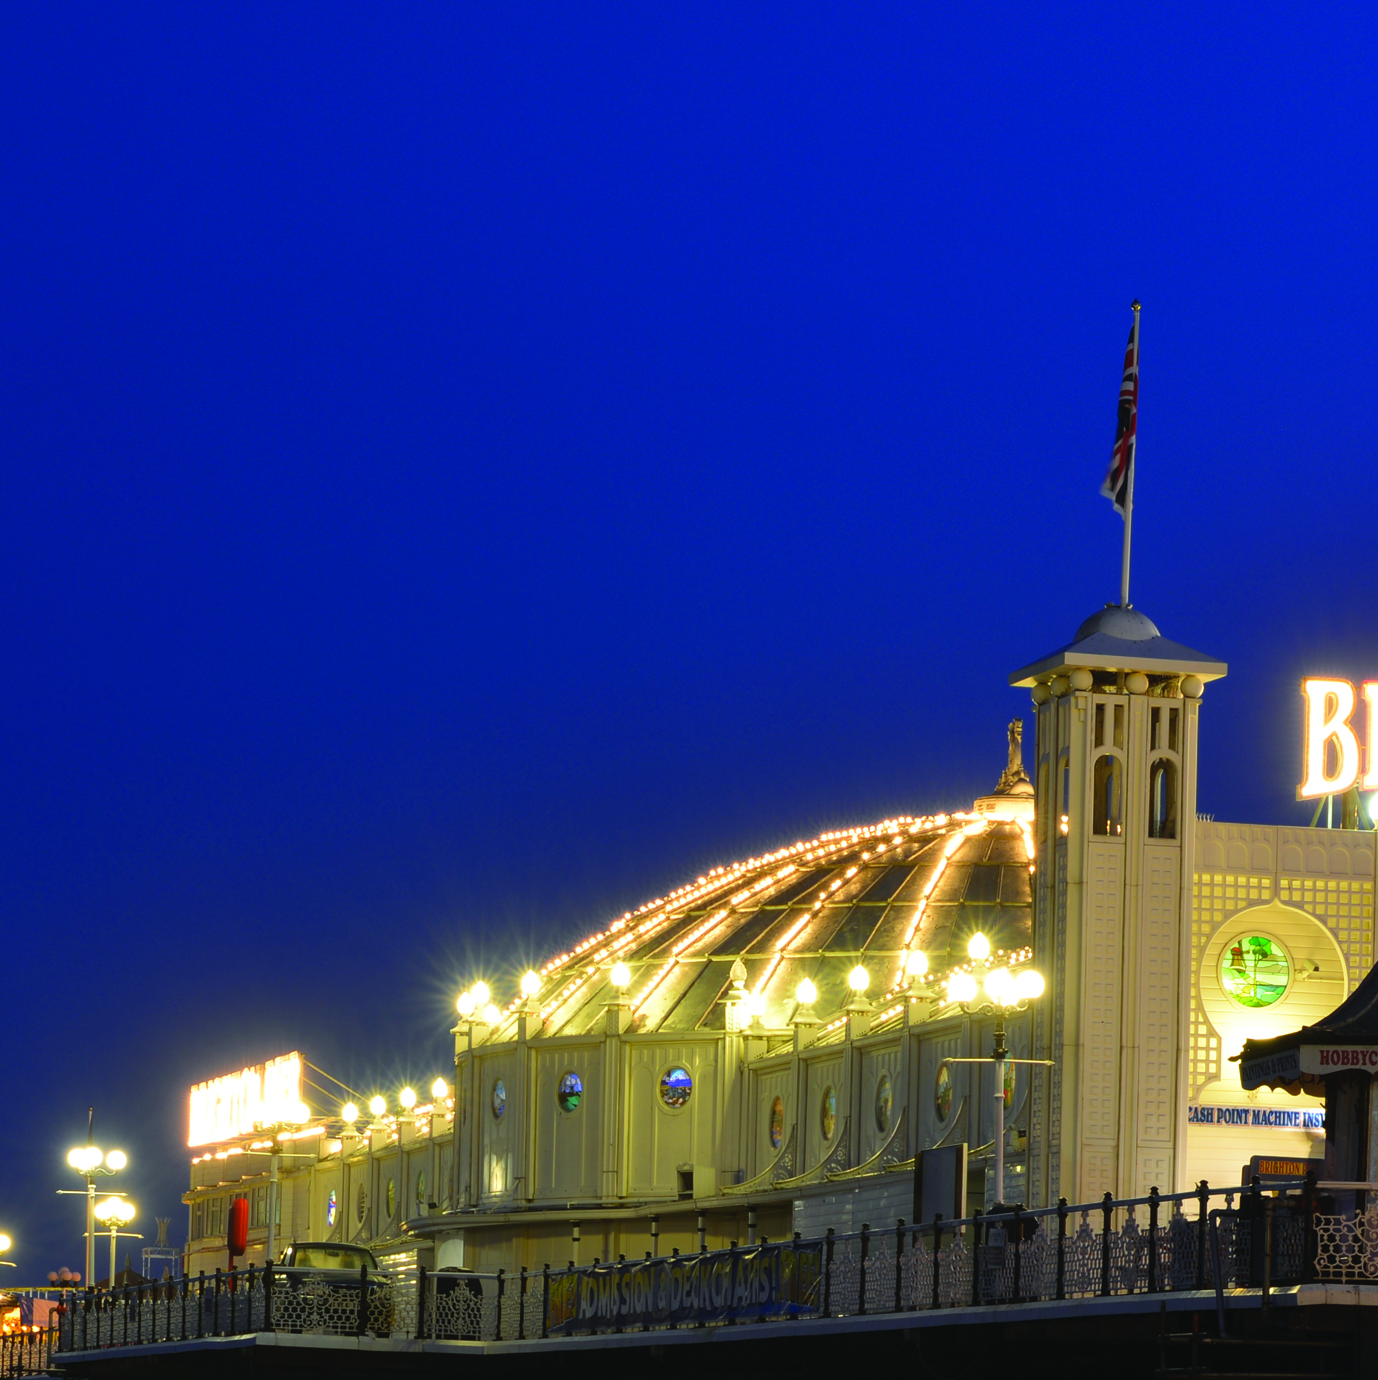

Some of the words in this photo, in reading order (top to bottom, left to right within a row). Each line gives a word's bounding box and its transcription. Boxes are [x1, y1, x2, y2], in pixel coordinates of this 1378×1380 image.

[1216, 1107, 1250, 1126] POINT
[1251, 1109, 1300, 1128] MACHINE
[1259, 1160, 1301, 1175] BRIGHTON
[579, 1266, 655, 1320] ADMISSION
[656, 1271, 667, 1311] &
